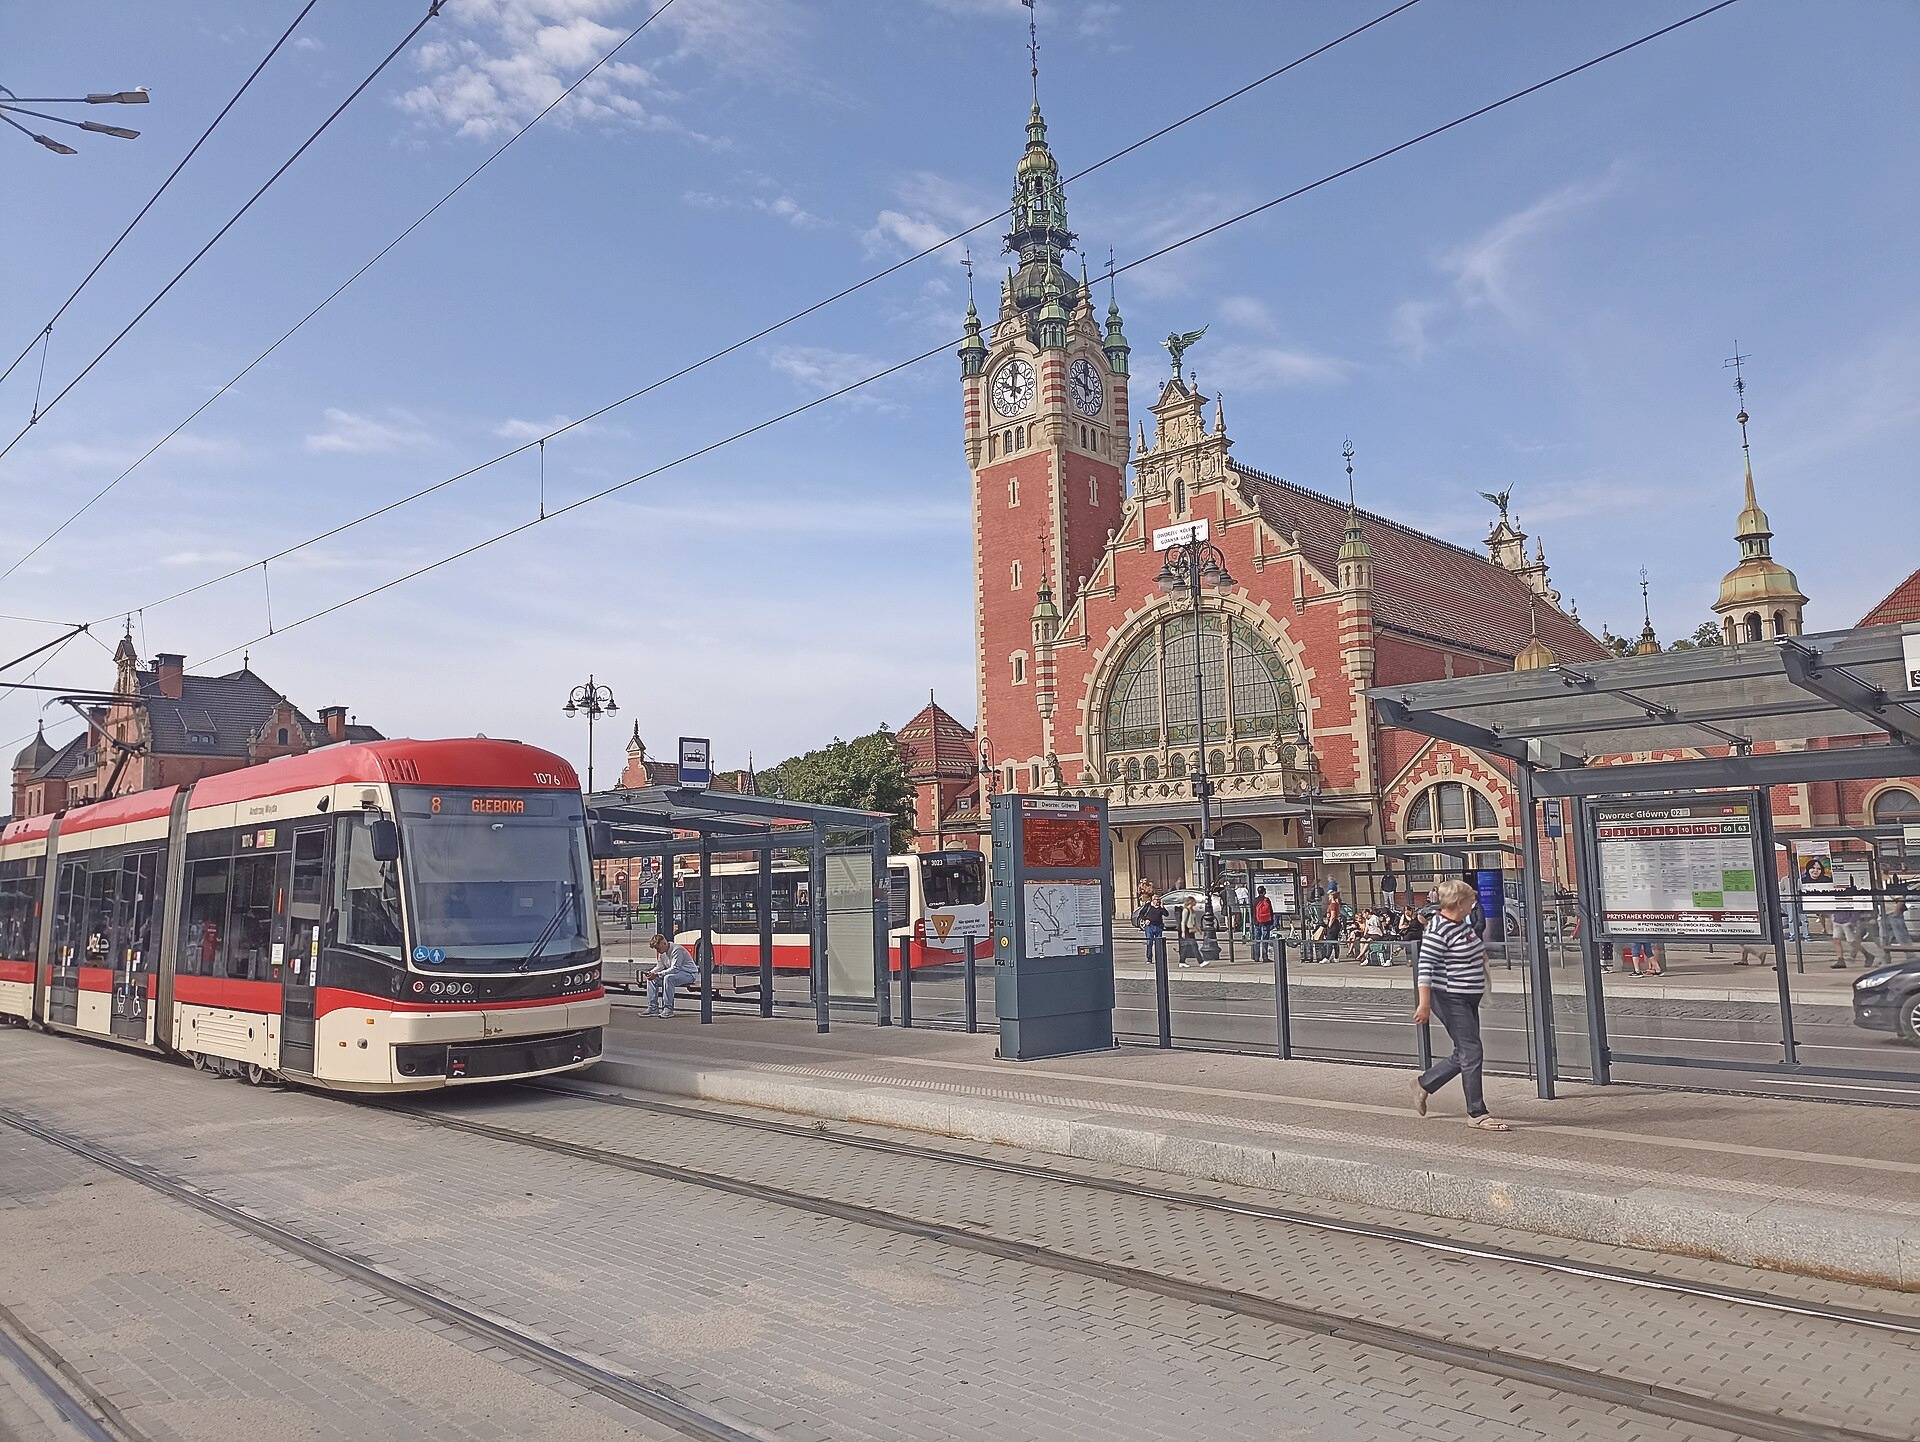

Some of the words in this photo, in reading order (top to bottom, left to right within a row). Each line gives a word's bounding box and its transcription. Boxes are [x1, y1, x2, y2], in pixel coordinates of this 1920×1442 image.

[534, 772, 560, 786] 1076
[432, 796, 440, 814] 8
[1636, 810, 1669, 819] Główny
